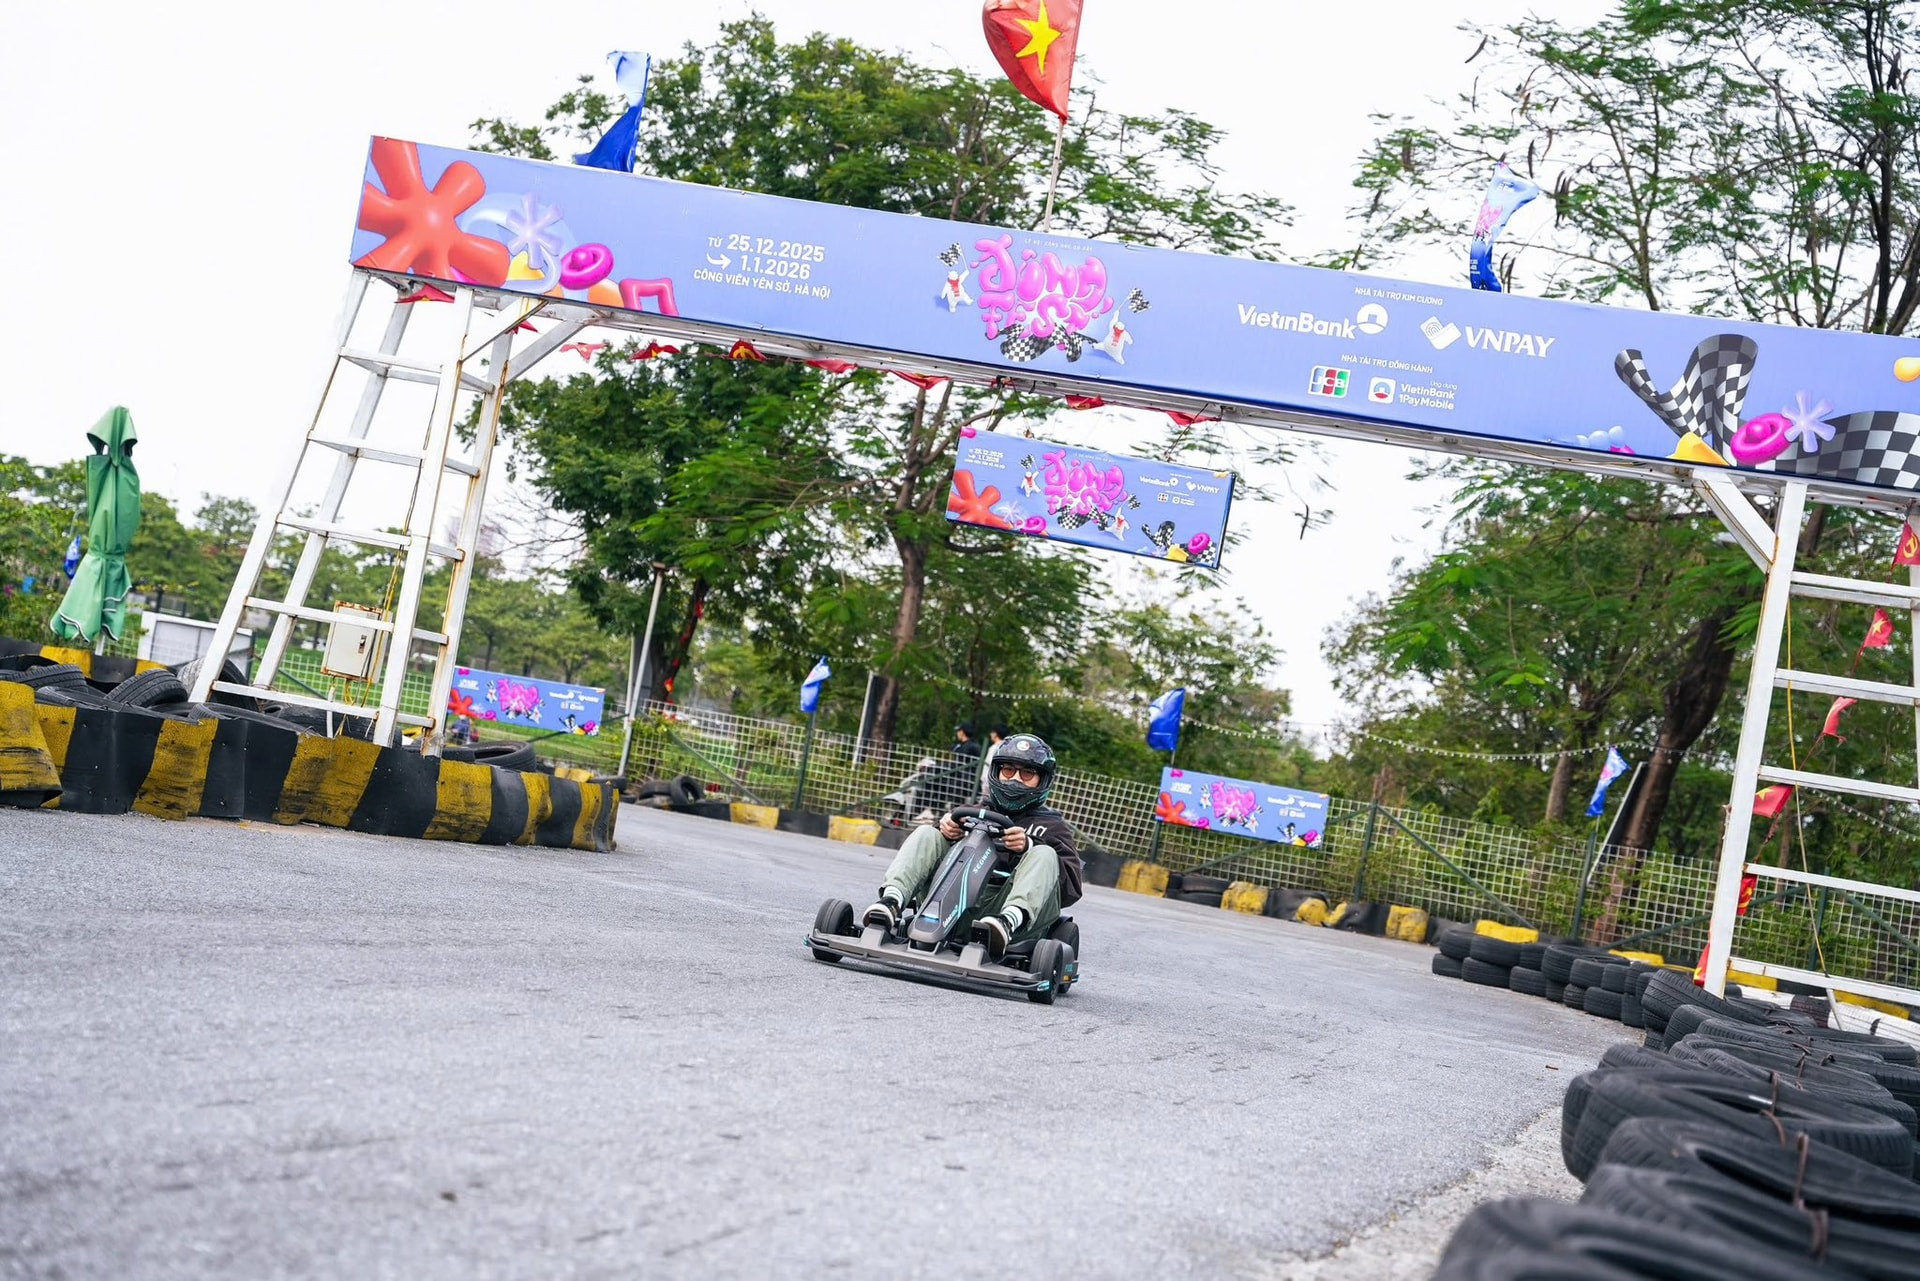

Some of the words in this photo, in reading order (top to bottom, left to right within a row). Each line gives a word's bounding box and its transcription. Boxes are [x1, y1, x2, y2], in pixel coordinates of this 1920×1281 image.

[708, 236, 723, 248] TỪ
[727, 234, 825, 262] 25.12.2025
[740, 254, 811, 280] 1.1.2026
[693, 268, 723, 282] CÔNG
[725, 273, 750, 286] VIÊN
[752, 277, 774, 290] YÊN
[794, 283, 810, 295] HÀ
[812, 286, 831, 300] NỘI
[1354, 286, 1372, 297] NHÀ
[1401, 293, 1416, 302] KIM
[1237, 303, 1357, 339] VietinBank
[1465, 326, 1555, 358] VNPAY
[1341, 353, 1358, 364] NHÀ
[1401, 383, 1456, 399] VietinBank
[972, 847, 993, 874] SEGWAY
